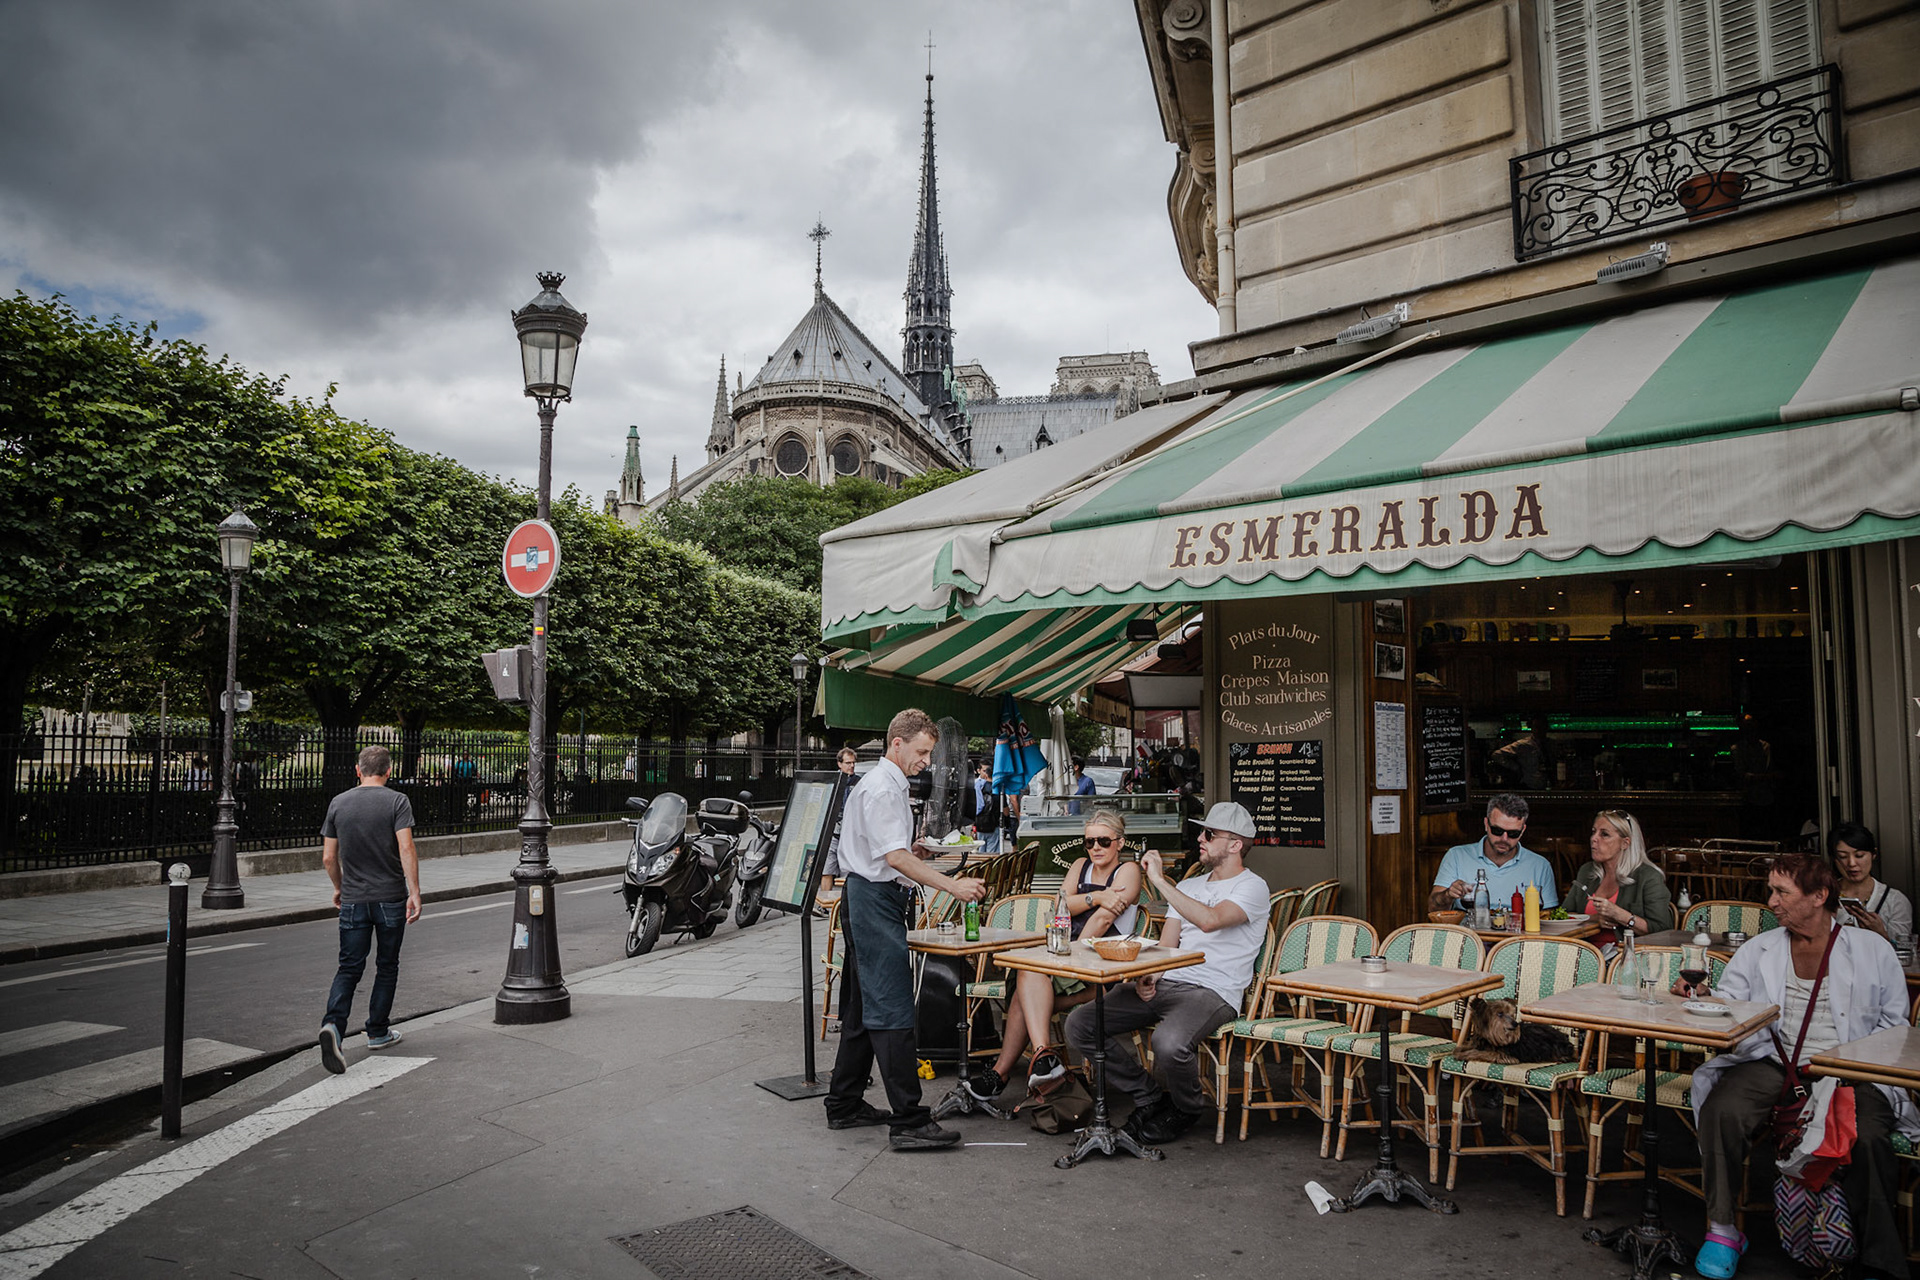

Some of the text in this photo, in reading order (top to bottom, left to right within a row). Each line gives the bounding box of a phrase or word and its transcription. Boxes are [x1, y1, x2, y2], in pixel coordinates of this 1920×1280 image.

[1168, 482, 1549, 569] ESMERALDA
[1228, 623, 1320, 650] Plats du Jour
[1252, 655, 1291, 670] Pizza
[1277, 670, 1328, 686] Maison
[1220, 688, 1326, 706] Club sandwiches
[1222, 708, 1332, 736] Glaces Artisanales
[1256, 742, 1293, 755] BRUNCH
[1051, 838, 1084, 854] Glaces
